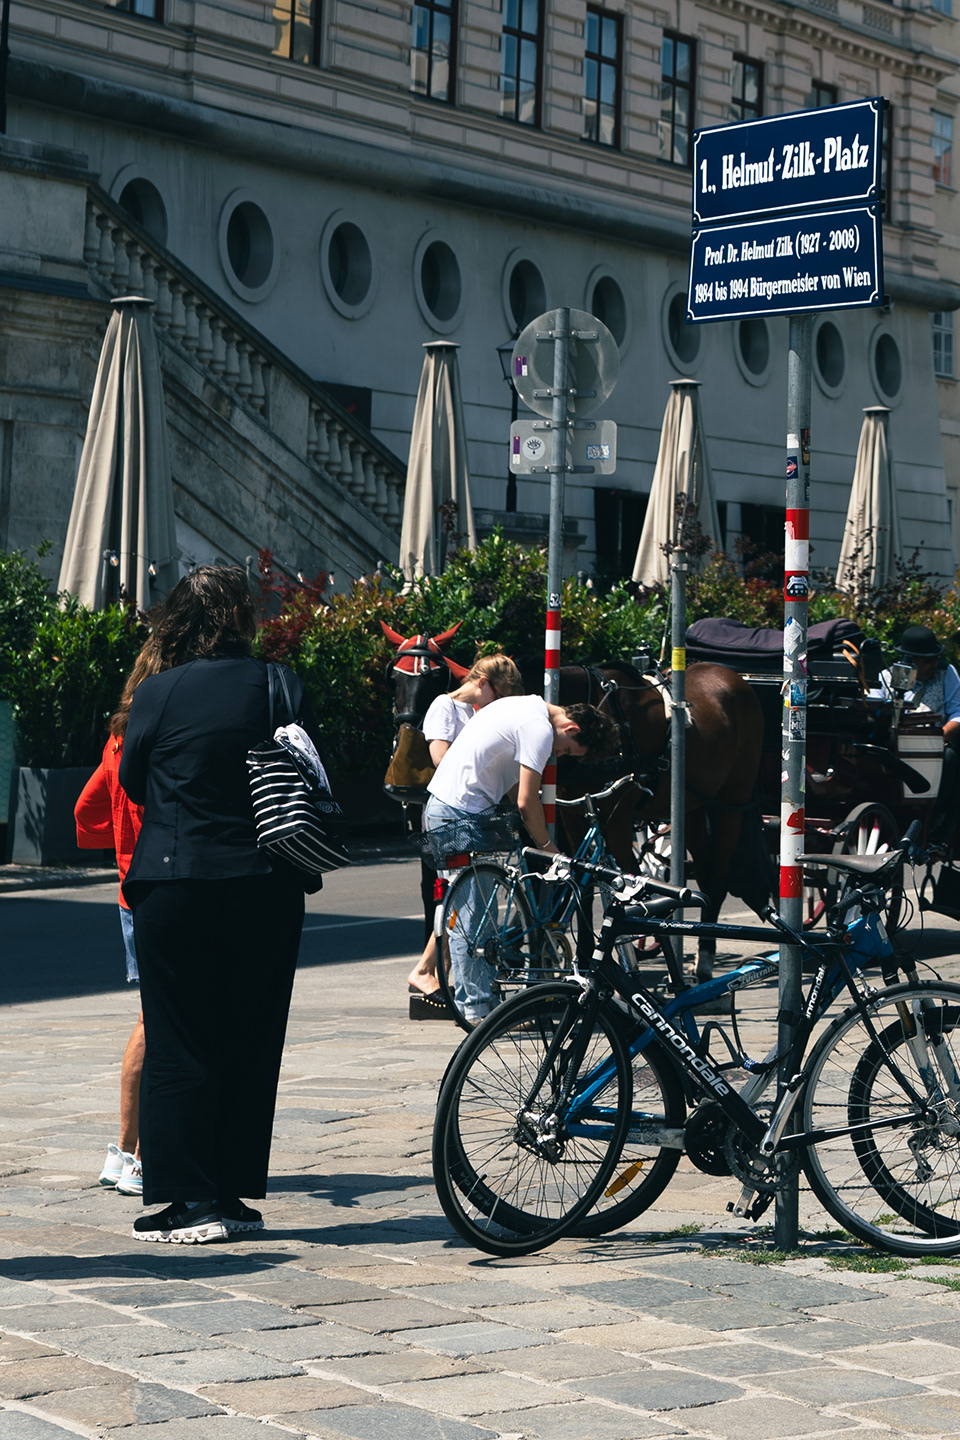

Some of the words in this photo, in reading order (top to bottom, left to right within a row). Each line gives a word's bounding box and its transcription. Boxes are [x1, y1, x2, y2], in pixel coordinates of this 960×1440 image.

[700, 159, 716, 194] 1.,
[721, 133, 869, 190] Helmut-Zilk-Platz
[704, 246, 726, 266] Prof.
[726, 243, 740, 263] Dr.
[741, 239, 774, 262] Helmut
[775, 235, 794, 258] Zilk
[795, 231, 821, 259] (1927
[829, 224, 861, 253] 2008)
[694, 282, 713, 304] 1984
[714, 280, 728, 302] bis
[729, 278, 749, 300] 1994
[750, 272, 819, 301] Bürgermeister
[821, 273, 841, 291] von
[842, 266, 872, 288] Wien
[631, 992, 730, 1097] cannondale
